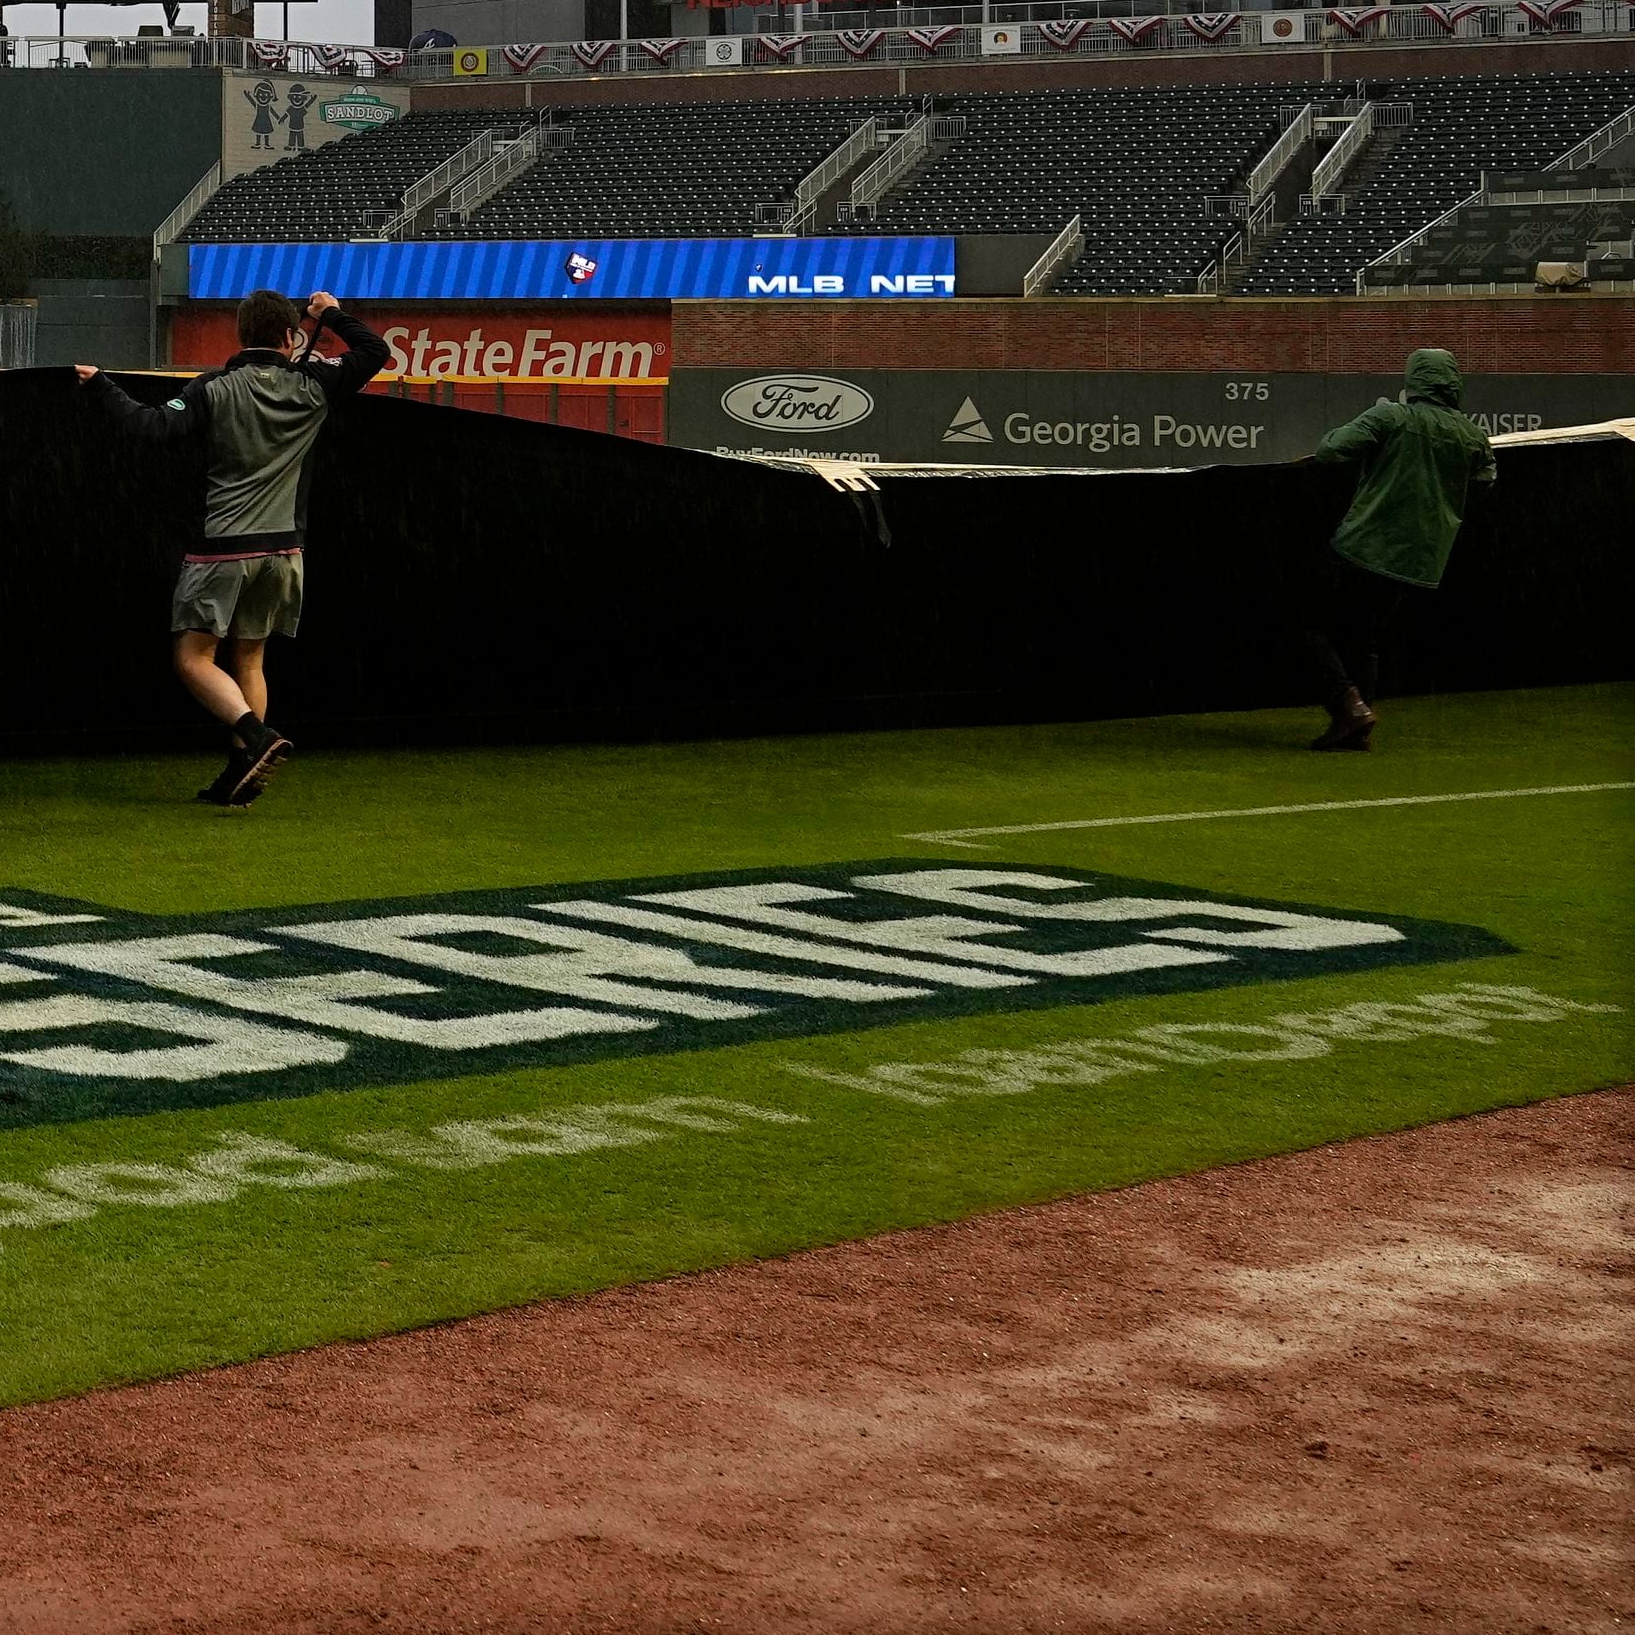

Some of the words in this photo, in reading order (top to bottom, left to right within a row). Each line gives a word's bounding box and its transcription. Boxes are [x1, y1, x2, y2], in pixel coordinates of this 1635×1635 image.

[327, 106, 393, 121] SANDLOT
[748, 275, 844, 295] MLB
[1225, 382, 1270, 401] 375
[752, 382, 843, 422] Ford
[1003, 413, 1141, 459] Georgia
[1153, 414, 1265, 450] Power
